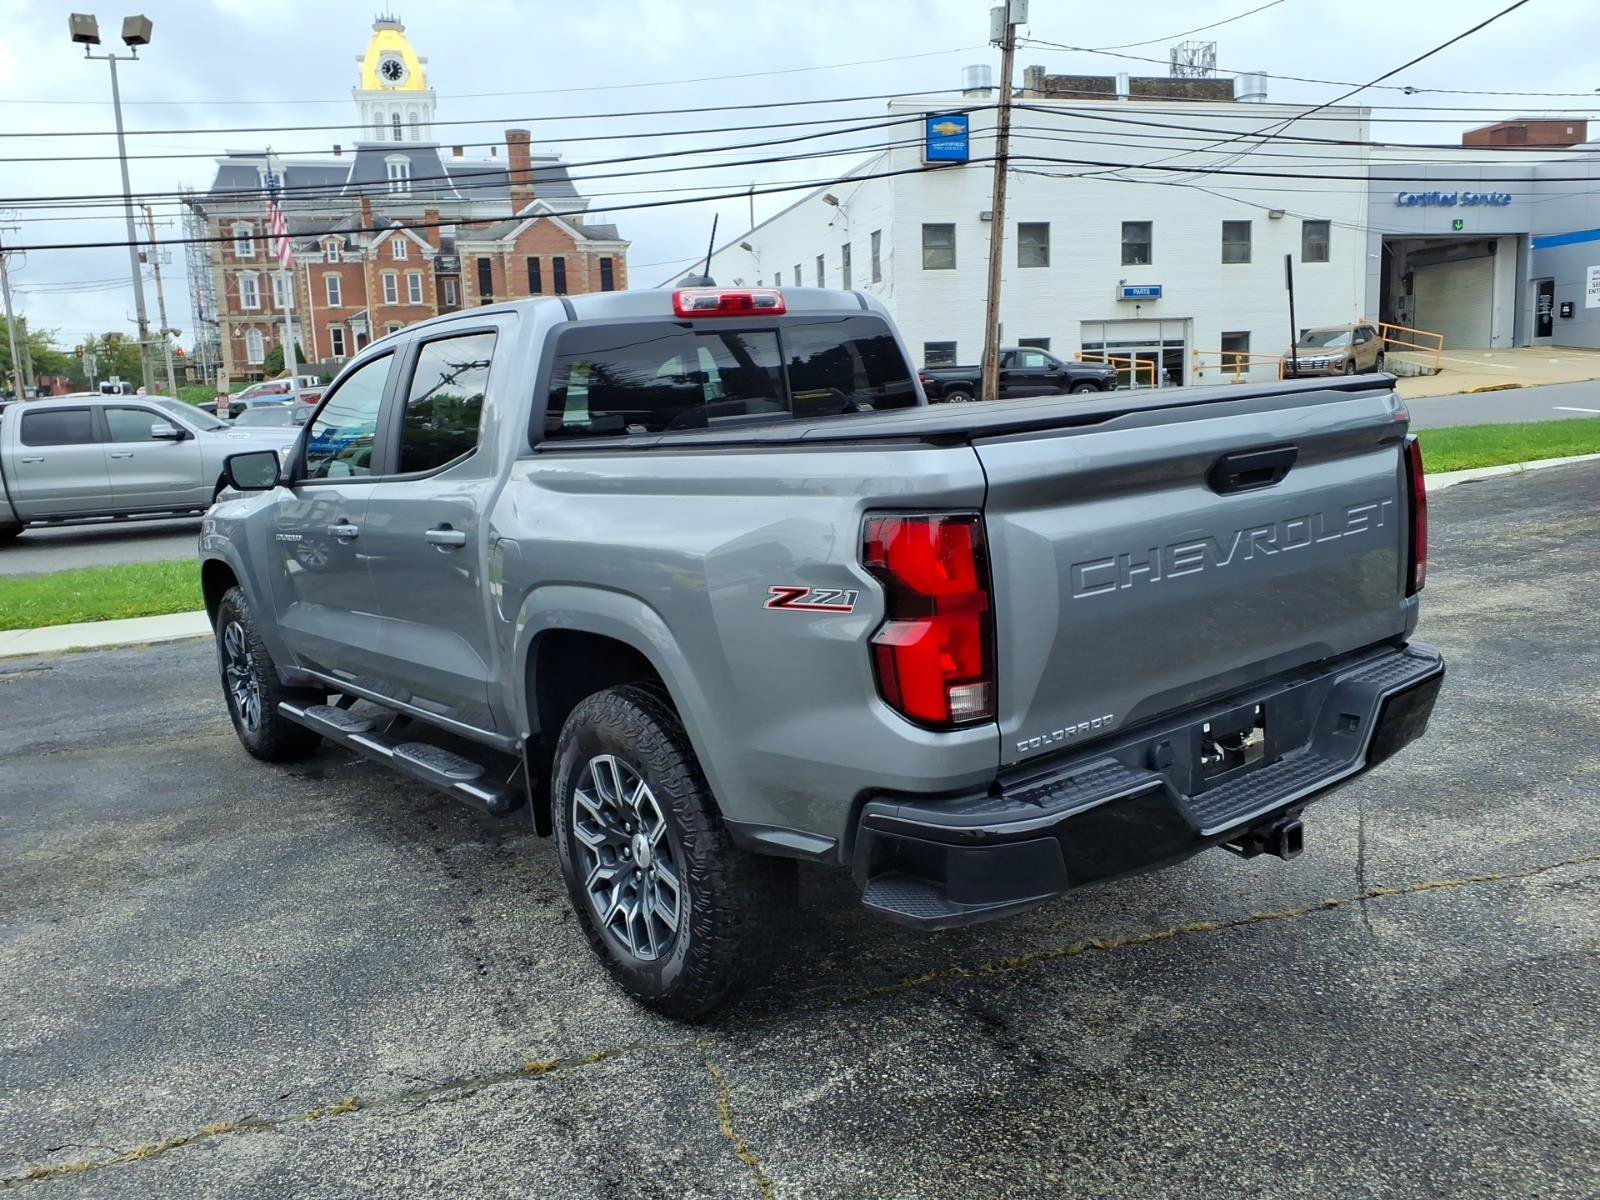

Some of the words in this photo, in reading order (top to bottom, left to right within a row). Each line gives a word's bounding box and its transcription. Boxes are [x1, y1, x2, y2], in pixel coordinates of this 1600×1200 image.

[1397, 191, 1458, 207] Certified
[1460, 191, 1512, 207] Service
[1070, 497, 1393, 599] CHEVROLET
[763, 585, 859, 613] Z71
[1016, 714, 1114, 752] COLORADO
